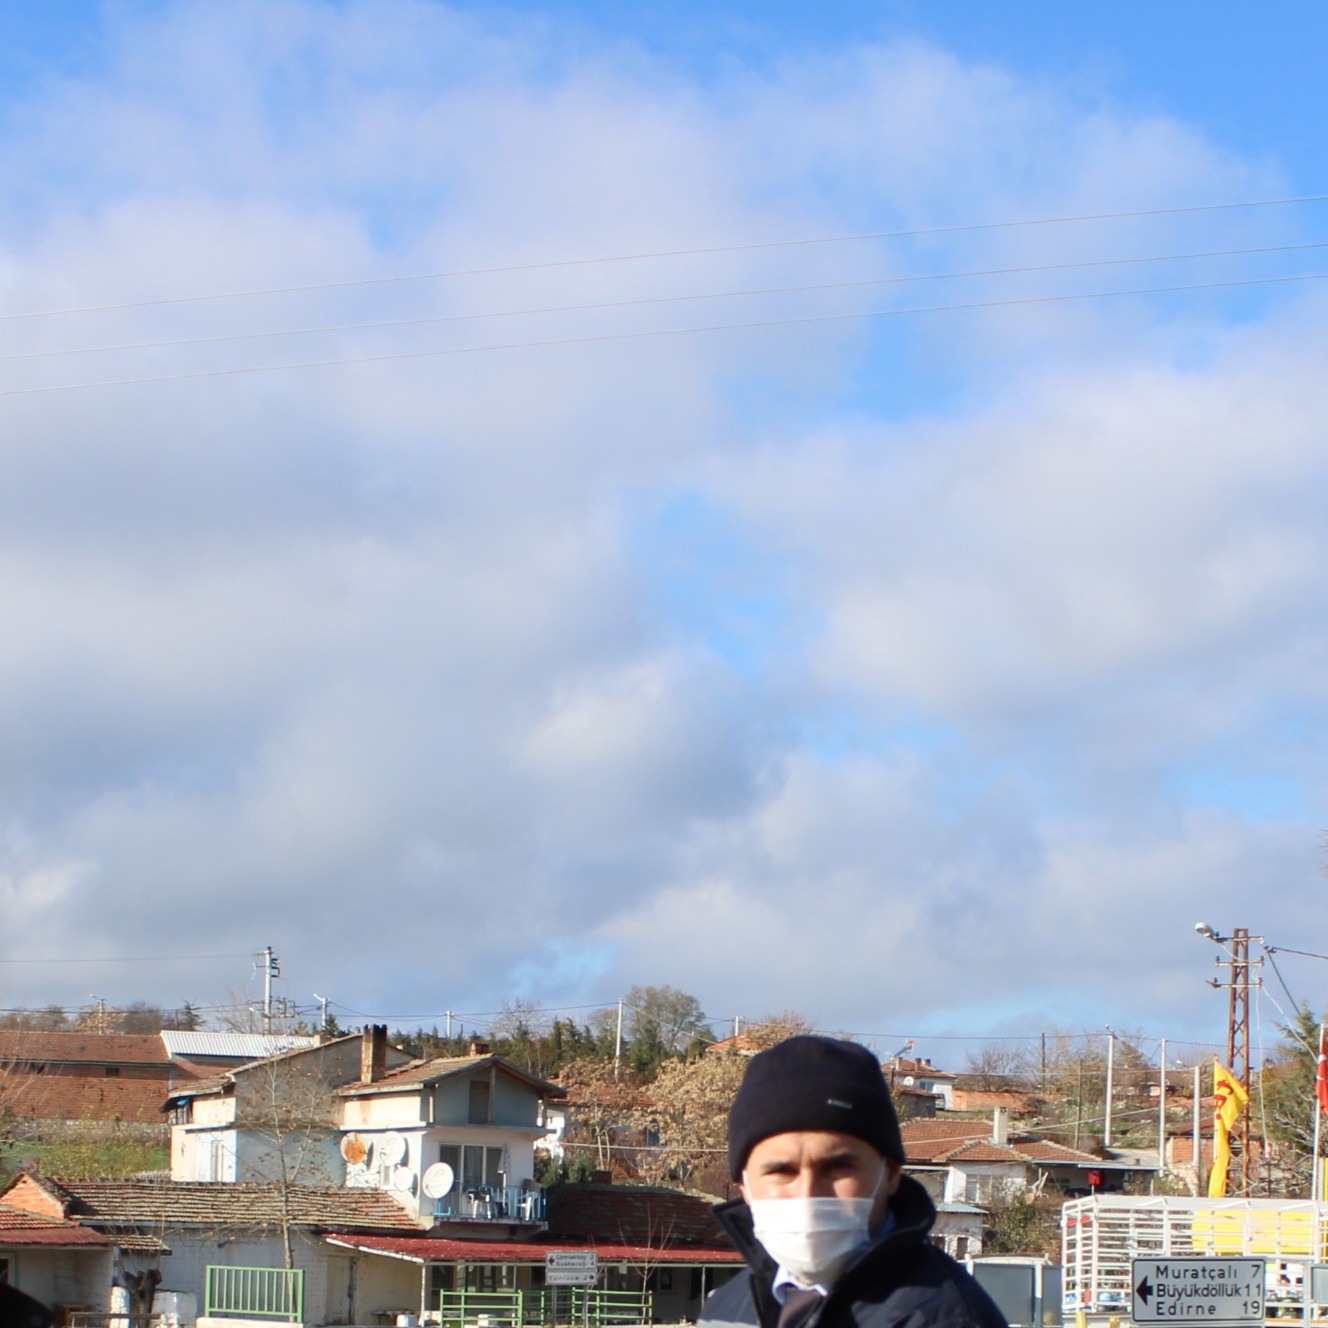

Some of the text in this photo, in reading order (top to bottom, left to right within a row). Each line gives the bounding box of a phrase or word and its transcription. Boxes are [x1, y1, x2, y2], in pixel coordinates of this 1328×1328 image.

[1156, 1265, 1261, 1280] Muratçalı 7
[1157, 1283, 1261, 1301] Büyükdöllük 11
[1156, 1301, 1260, 1315] Edirne 19
